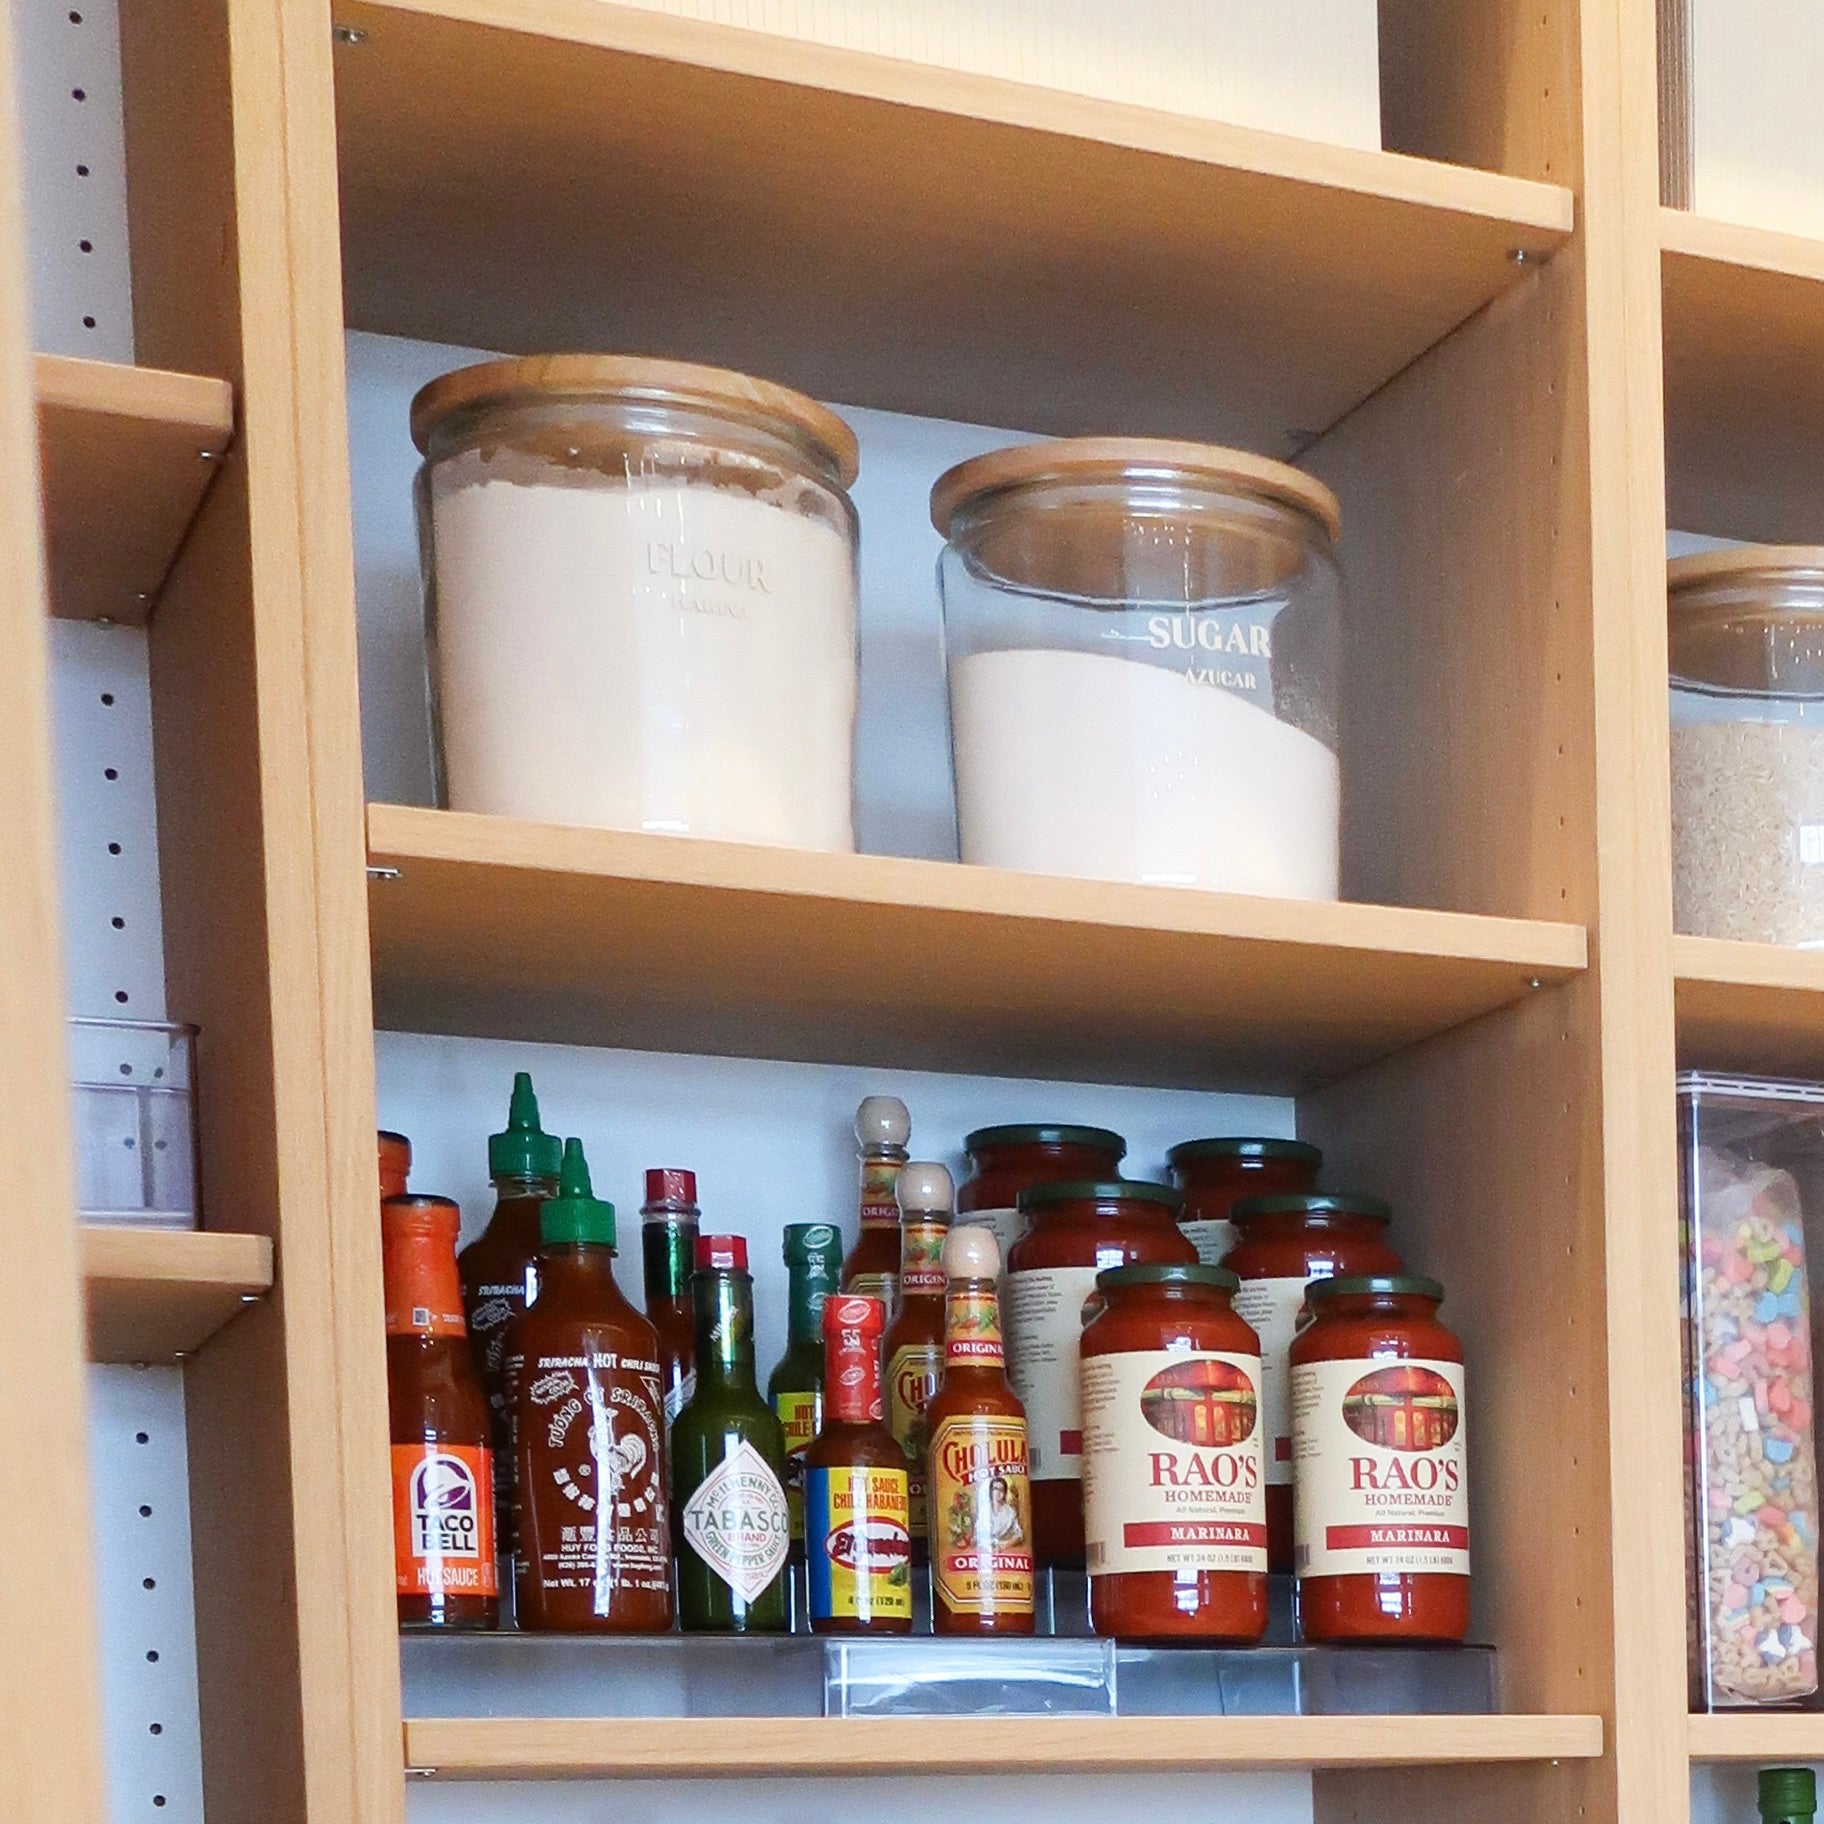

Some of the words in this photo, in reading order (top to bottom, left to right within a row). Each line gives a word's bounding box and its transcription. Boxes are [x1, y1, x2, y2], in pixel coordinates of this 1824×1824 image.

[646, 541, 772, 595] FLOUR
[1148, 615, 1272, 658] SUGAR
[538, 1357, 588, 1369] SRIRACHA
[593, 1353, 617, 1369] HOT
[968, 1468, 995, 1483] HOT
[1148, 1453, 1257, 1489] RAO'S
[1348, 1457, 1458, 1492] RAO'S
[872, 1478, 899, 1493] SAUCE
[1164, 1490, 1251, 1504] HOMEMADE
[1364, 1493, 1452, 1506] HOMEMADE
[416, 1514, 474, 1531] TACO
[691, 1510, 788, 1533] TABASCO
[422, 1533, 477, 1550] BELL
[1170, 1527, 1250, 1541] MARINARA
[1371, 1529, 1450, 1543] MARINARA
[444, 1567, 478, 1587] SAUCE
